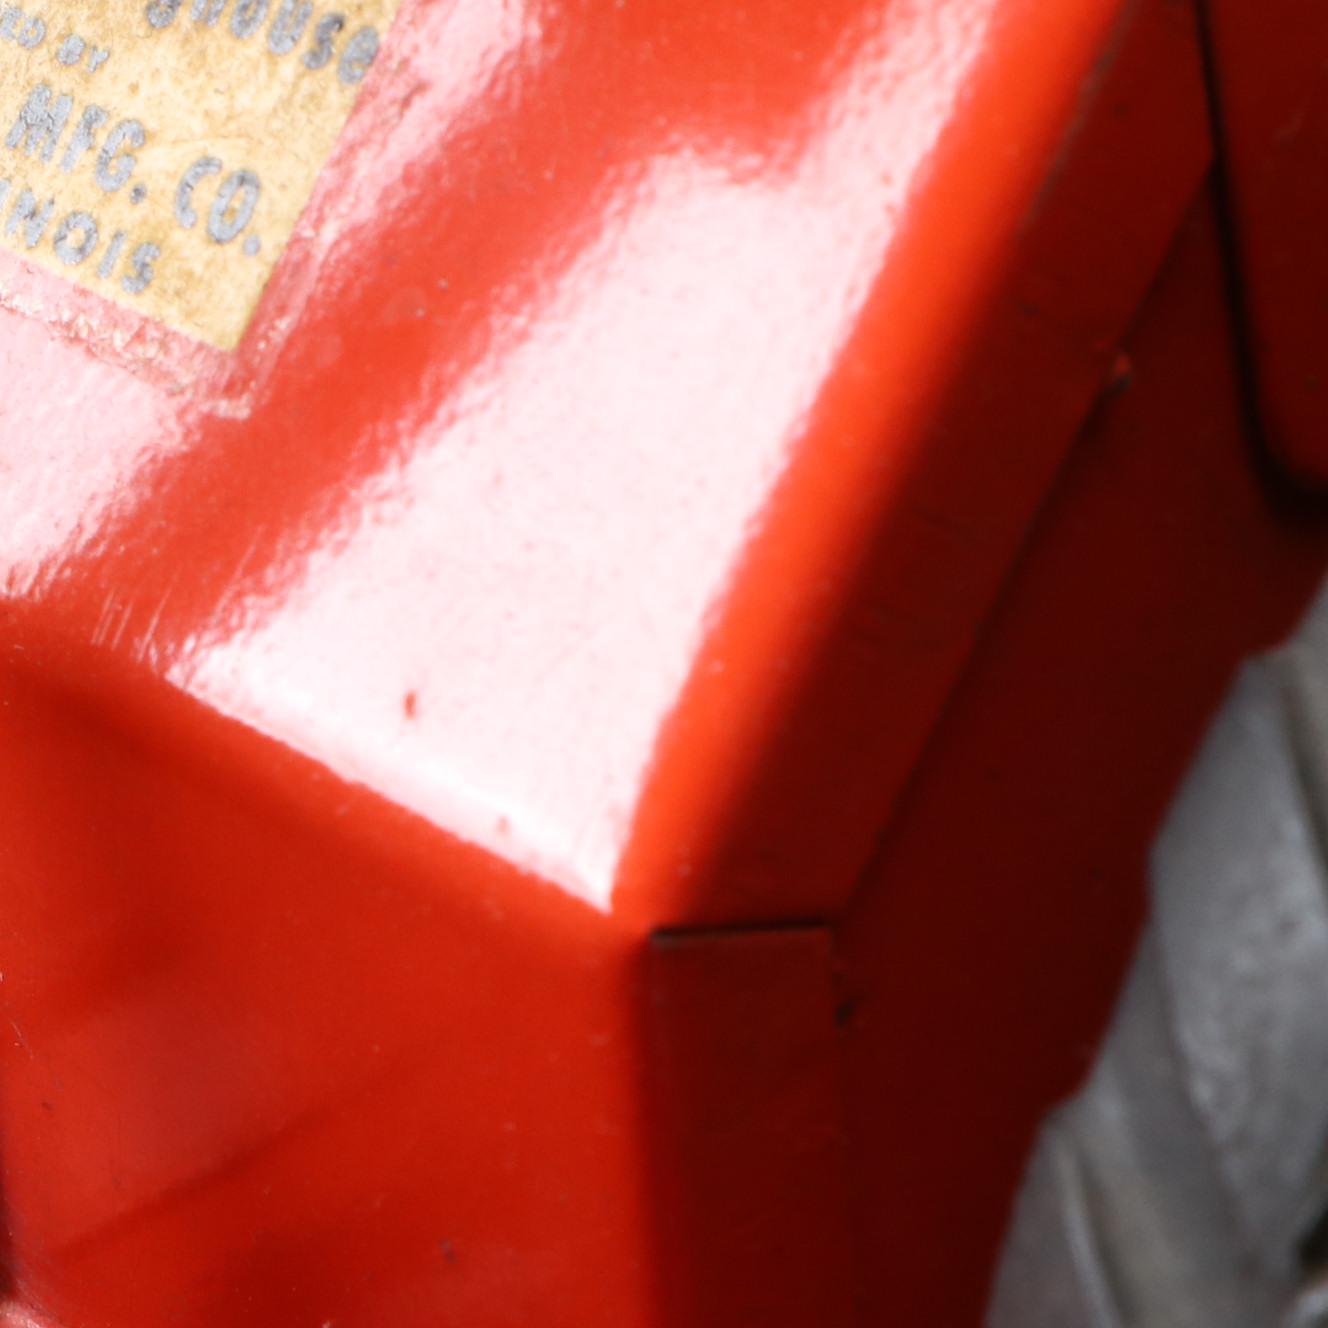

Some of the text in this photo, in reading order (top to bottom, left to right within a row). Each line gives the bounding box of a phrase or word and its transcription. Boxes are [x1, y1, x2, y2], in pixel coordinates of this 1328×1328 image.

[54, 31, 110, 73] BY
[6, 84, 149, 206] MFG.
[172, 154, 263, 256] CO.
